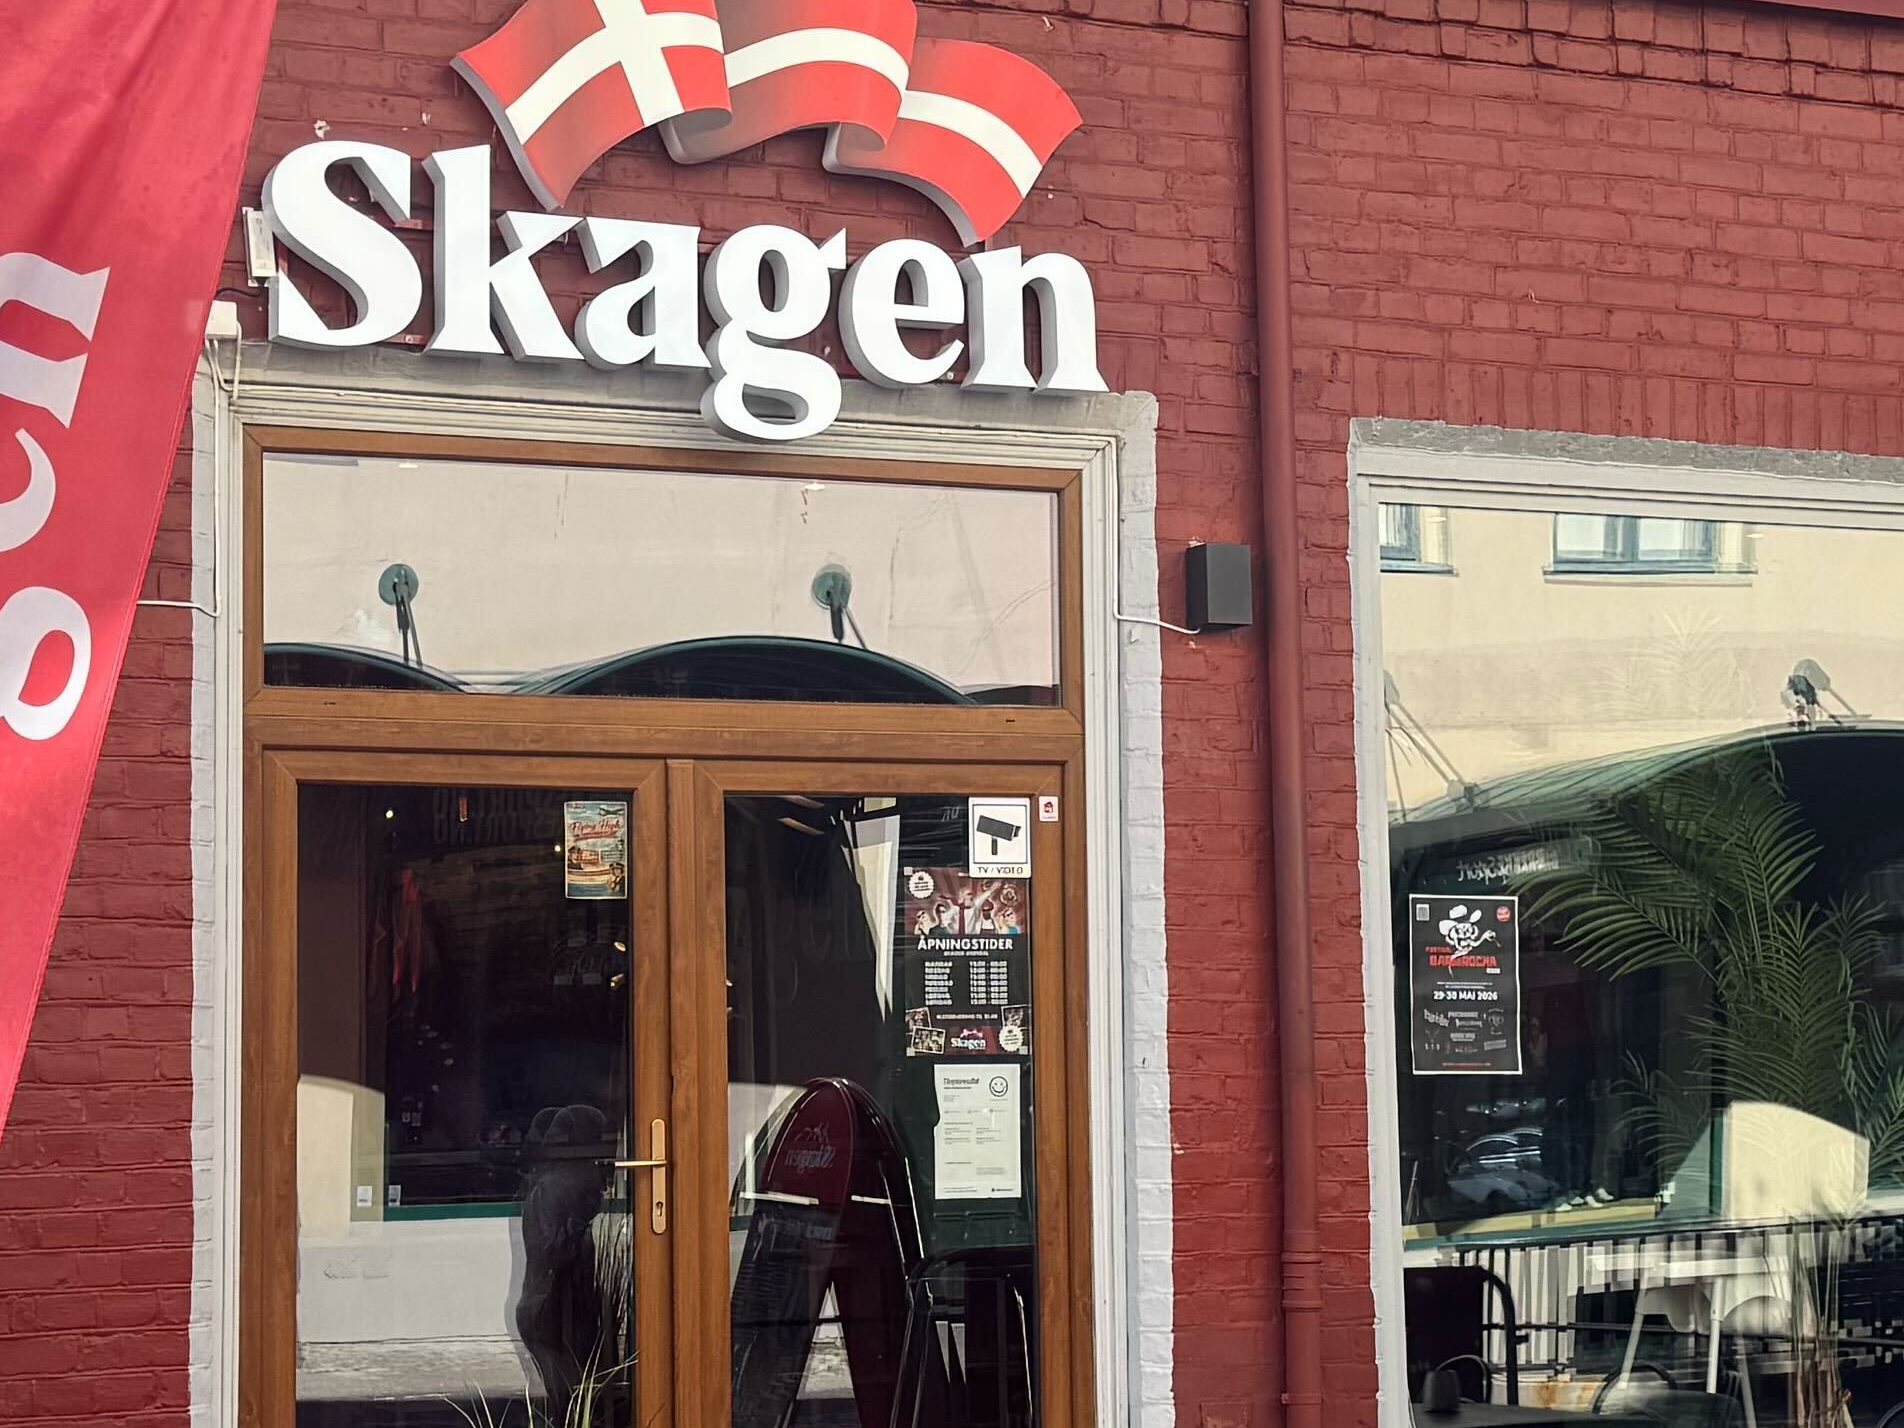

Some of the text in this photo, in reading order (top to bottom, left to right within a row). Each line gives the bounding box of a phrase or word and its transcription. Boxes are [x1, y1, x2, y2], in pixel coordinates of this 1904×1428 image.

[260, 140, 1109, 442] Skagen
[918, 934, 1014, 950] ÅPNINGSTIDER
[1459, 991, 1475, 1000] MAI
[1477, 991, 1498, 1000] 2026
